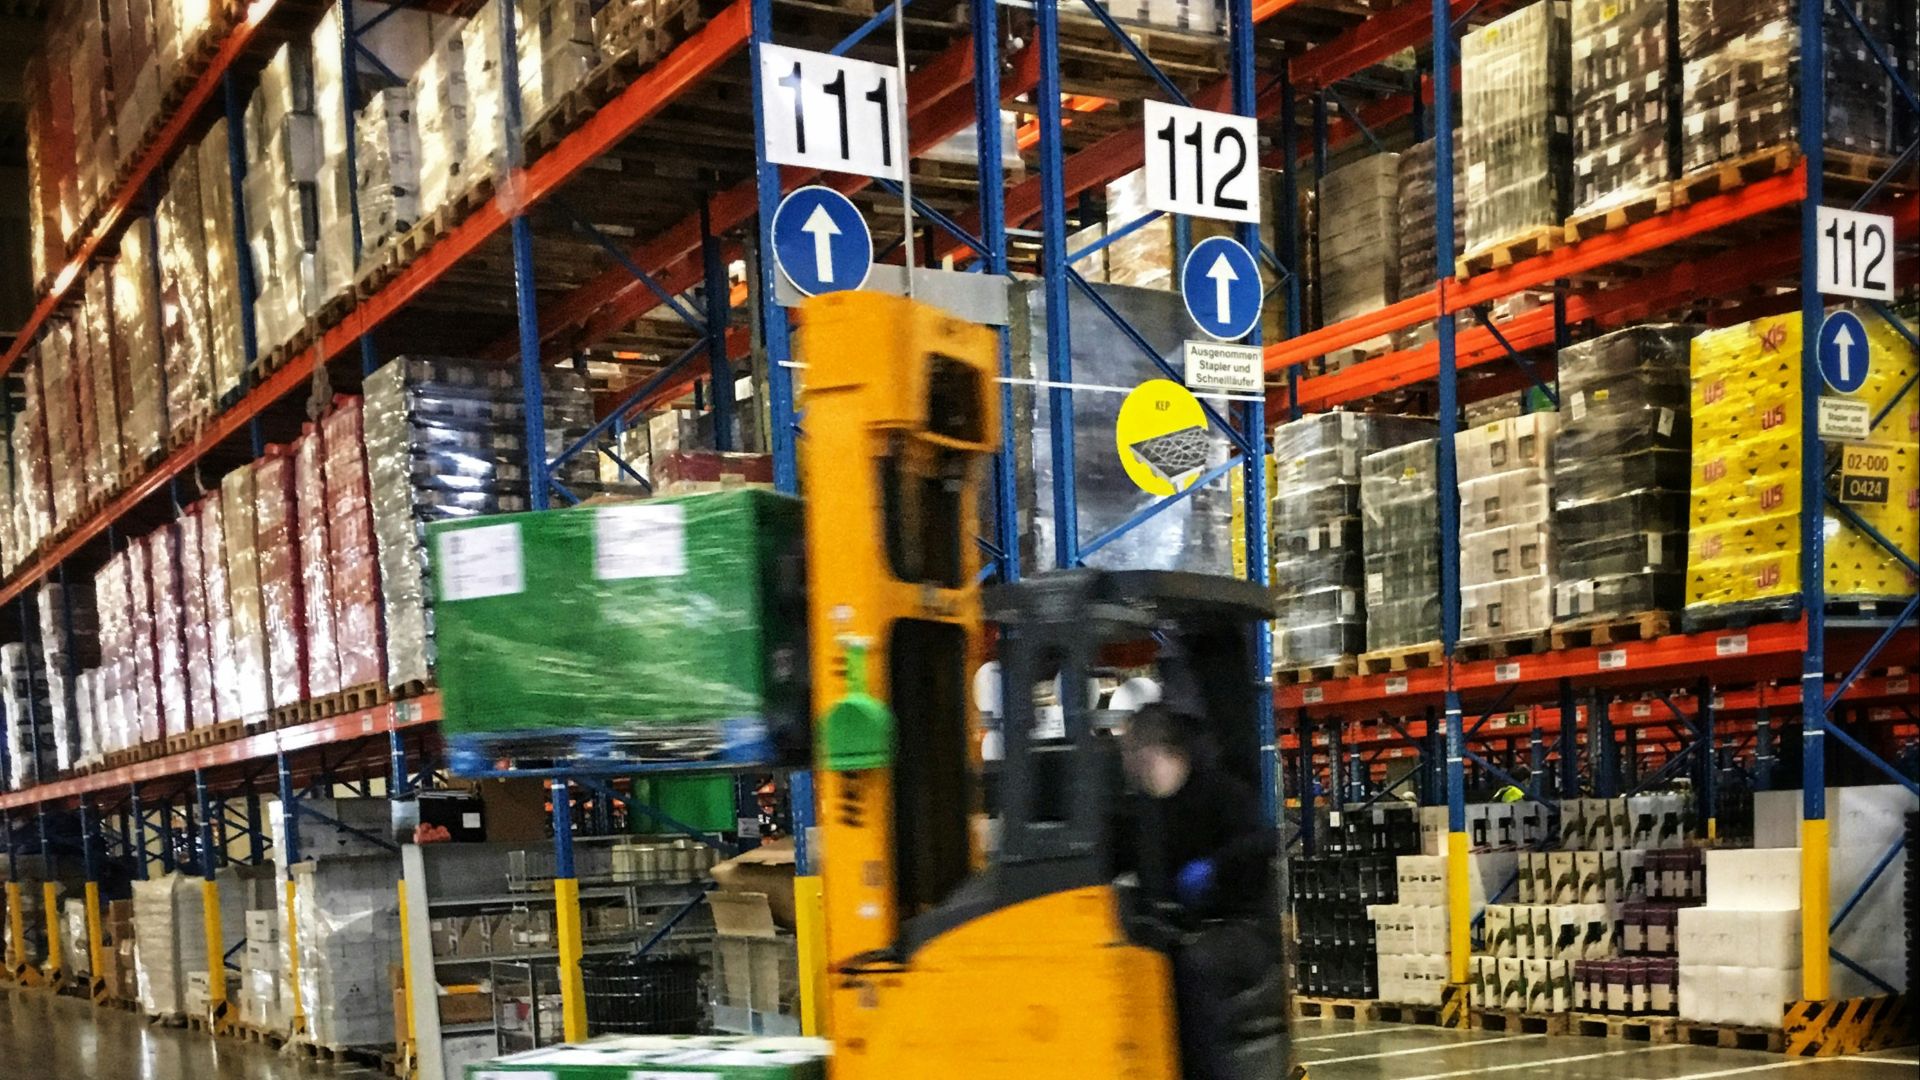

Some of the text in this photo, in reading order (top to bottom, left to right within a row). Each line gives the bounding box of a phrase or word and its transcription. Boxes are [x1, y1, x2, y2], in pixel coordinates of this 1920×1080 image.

[778, 61, 892, 167] 111
[1157, 116, 1248, 211] 112
[1825, 217, 1887, 291] 112
[1190, 345, 1259, 361] Ausgenommen
[1199, 359, 1251, 374] Stapler und
[1154, 400, 1171, 411] KEP
[1847, 453, 1889, 472] 02-000
